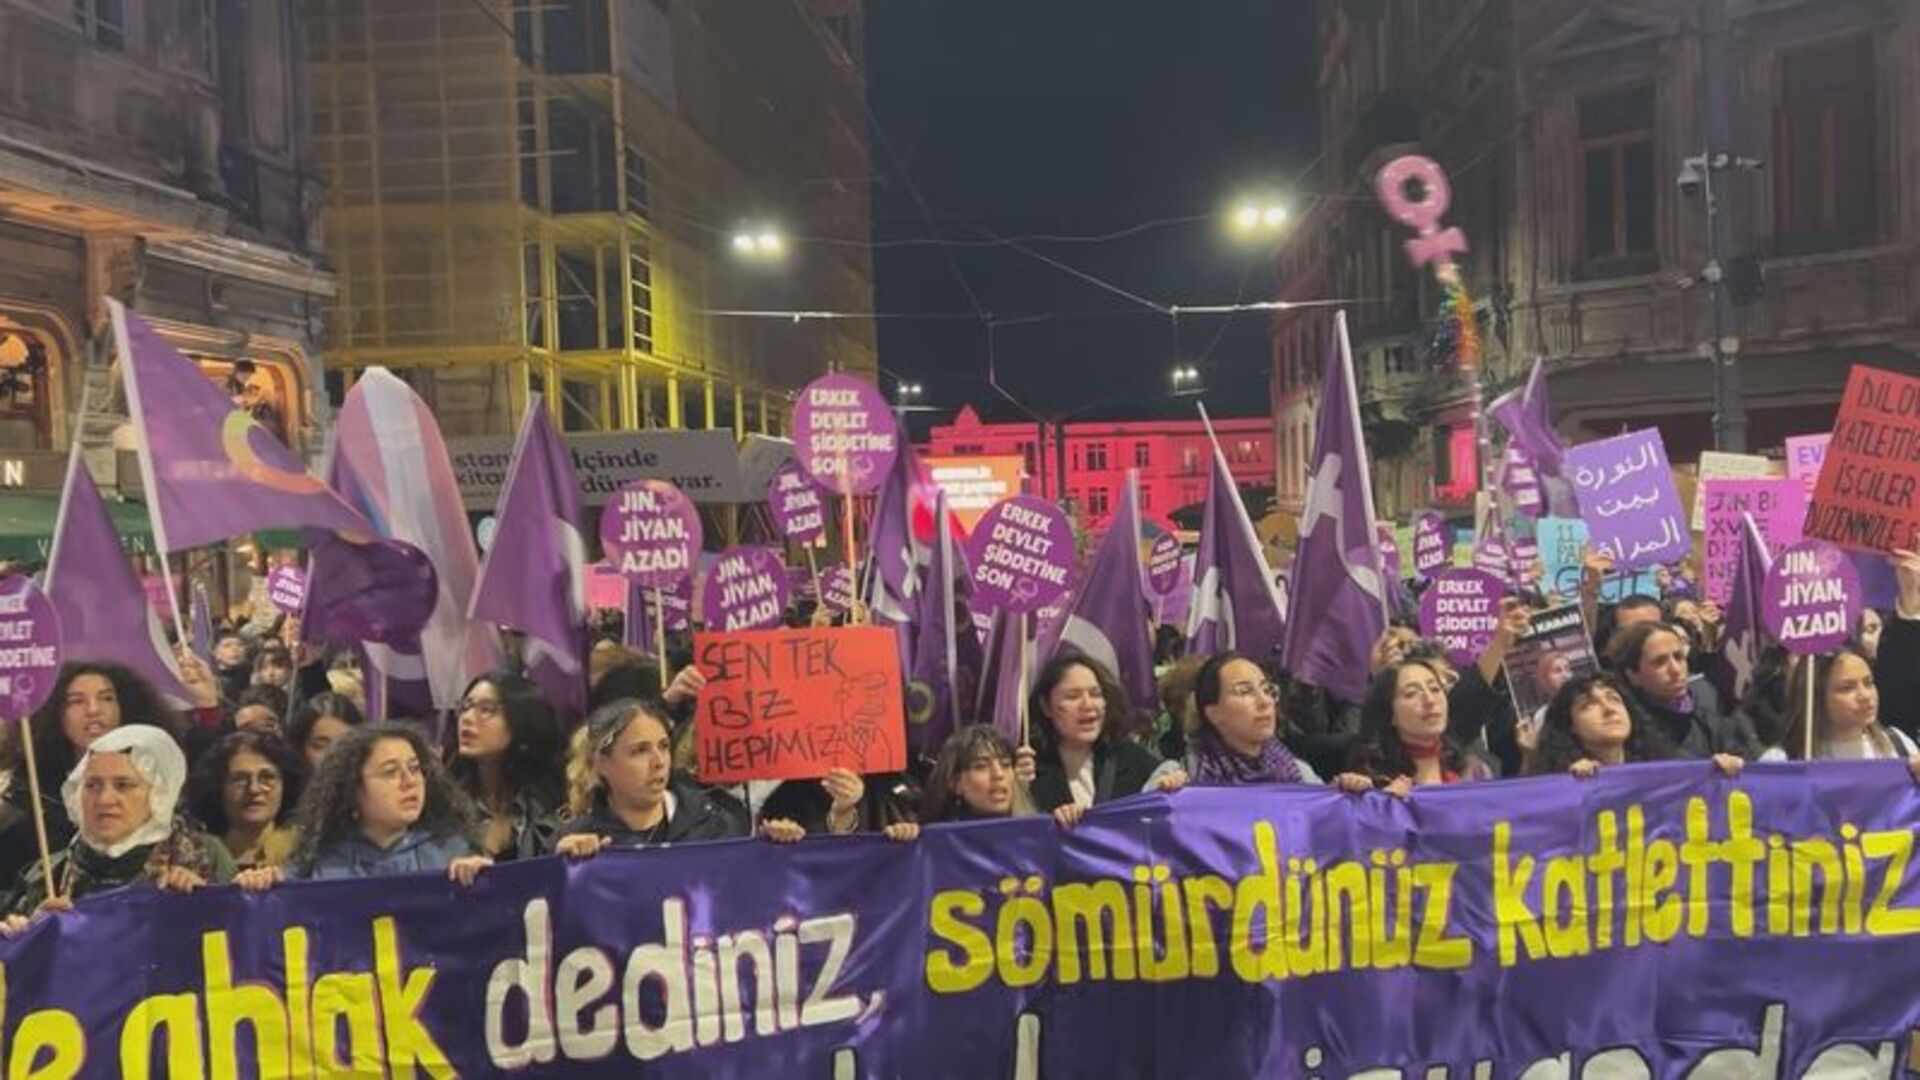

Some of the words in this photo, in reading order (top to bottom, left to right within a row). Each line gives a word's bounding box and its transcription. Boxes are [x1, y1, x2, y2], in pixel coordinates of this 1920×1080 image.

[810, 411, 869, 429] DEVLET
[1000, 503, 1052, 533] ERKEK
[992, 523, 1053, 555] DEVLET
[975, 565, 1015, 590] SON
[983, 544, 1068, 585] ŞİDDETİNE
[1438, 579, 1484, 594] ERKEK
[1436, 598, 1490, 613] DEVLET
[1780, 603, 1847, 640] AZADİ
[1436, 635, 1467, 649] ON
[702, 641, 771, 683] SEN
[784, 638, 846, 679] TEK
[484, 897, 885, 1069] dediniz,
[926, 820, 1473, 993] sömürdünüz
[1493, 790, 1920, 967] katlettiniz
